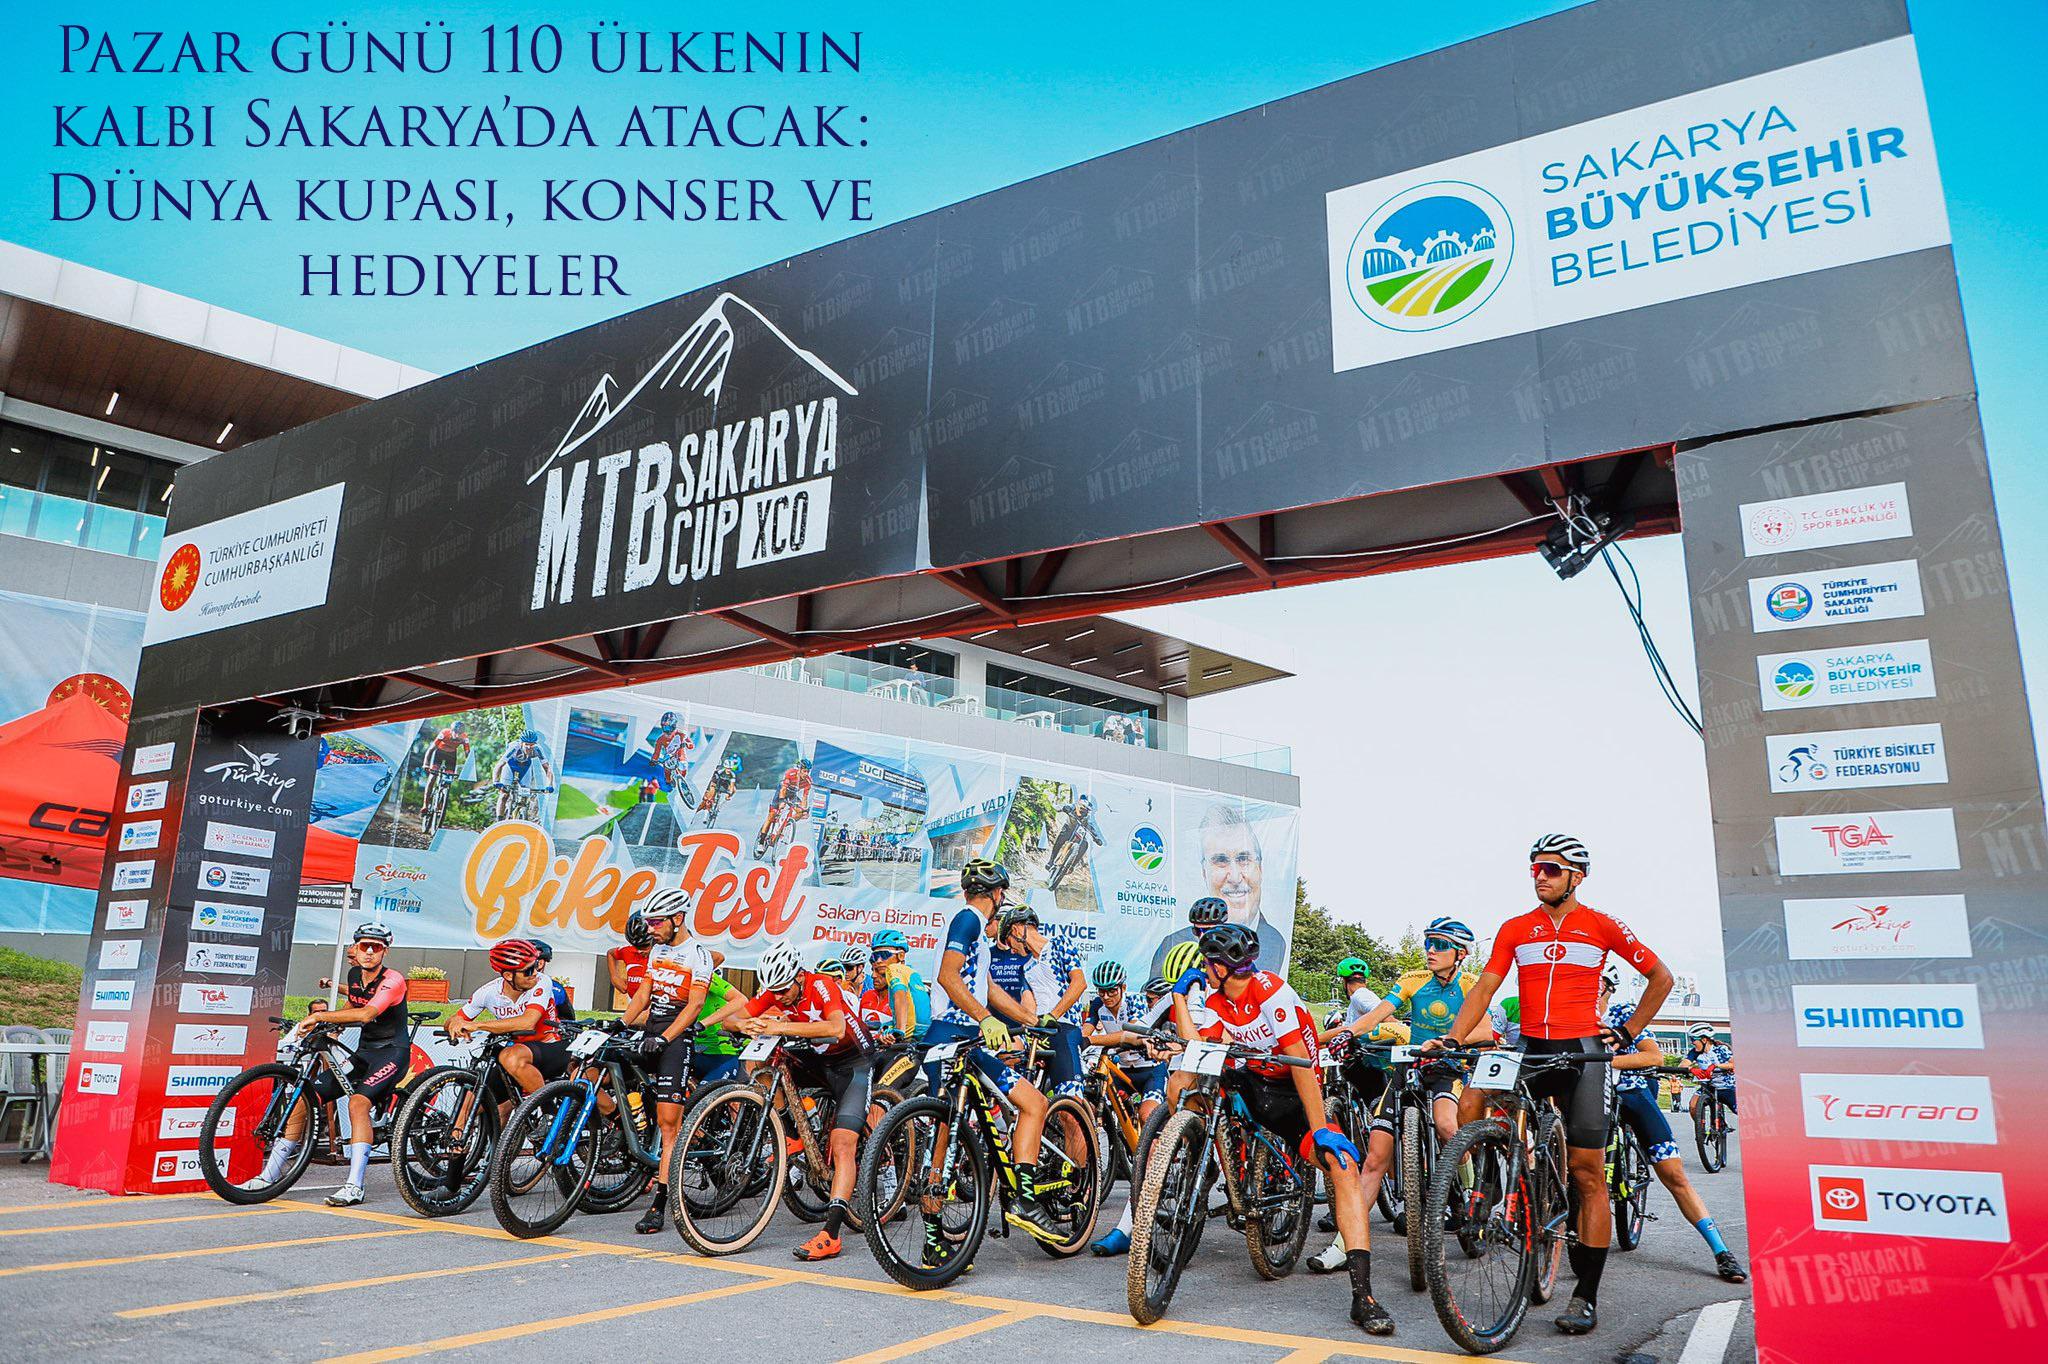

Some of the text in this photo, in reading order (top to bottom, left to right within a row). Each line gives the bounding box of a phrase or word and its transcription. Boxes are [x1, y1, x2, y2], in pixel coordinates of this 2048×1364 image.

[1542, 105, 1797, 193] SAKARYA
[1545, 125, 1908, 240] BÜYÜKŞEHİR
[1551, 185, 1871, 287] BELEDİYESİ
[531, 396, 838, 610] MTB SAKARYA
[1880, 500, 1896, 510] VE
[1803, 521, 1832, 532] SPOR
[210, 516, 328, 564] TÜRKİYE CUMHURİYETİ
[668, 490, 809, 585] CUP XCO
[205, 541, 323, 586] CUMHURBAŞKANLIĞI
[1822, 578, 1868, 590] TÜRKİYE
[1823, 583, 1897, 599] CUMHURİYETİ
[1824, 596, 1873, 608] SAKARYA
[1826, 652, 1895, 668] SAKARYA
[1828, 663, 1921, 681] BÜYÜKŞEHİR
[1830, 678, 1914, 694] BELEDİYESİ
[1833, 743, 1935, 760] TÜRKİYE BİSİKLET
[1836, 762, 1920, 777] FEDERASYONU
[204, 757, 296, 804] Türkiye
[200, 794, 292, 816] goturkiye.com
[1811, 816, 1893, 856] TGA
[466, 822, 808, 940] Bike Fest
[1125, 880, 1169, 893] SAKARYA
[298, 897, 331, 905] ARATHON
[1117, 891, 1177, 906] BÜYÜKŞEHİR
[817, 903, 880, 924] Sakarya
[885, 909, 927, 926] Bizim
[1059, 922, 1096, 940] YÜCE
[96, 990, 130, 1002] SHIMANO
[1804, 1007, 1964, 1029] SHIMANO
[753, 1042, 764, 1053] 3
[93, 1073, 118, 1085] TOYOTA
[1488, 1063, 1502, 1078] 9
[1877, 1192, 1996, 1216] TOYOTA
